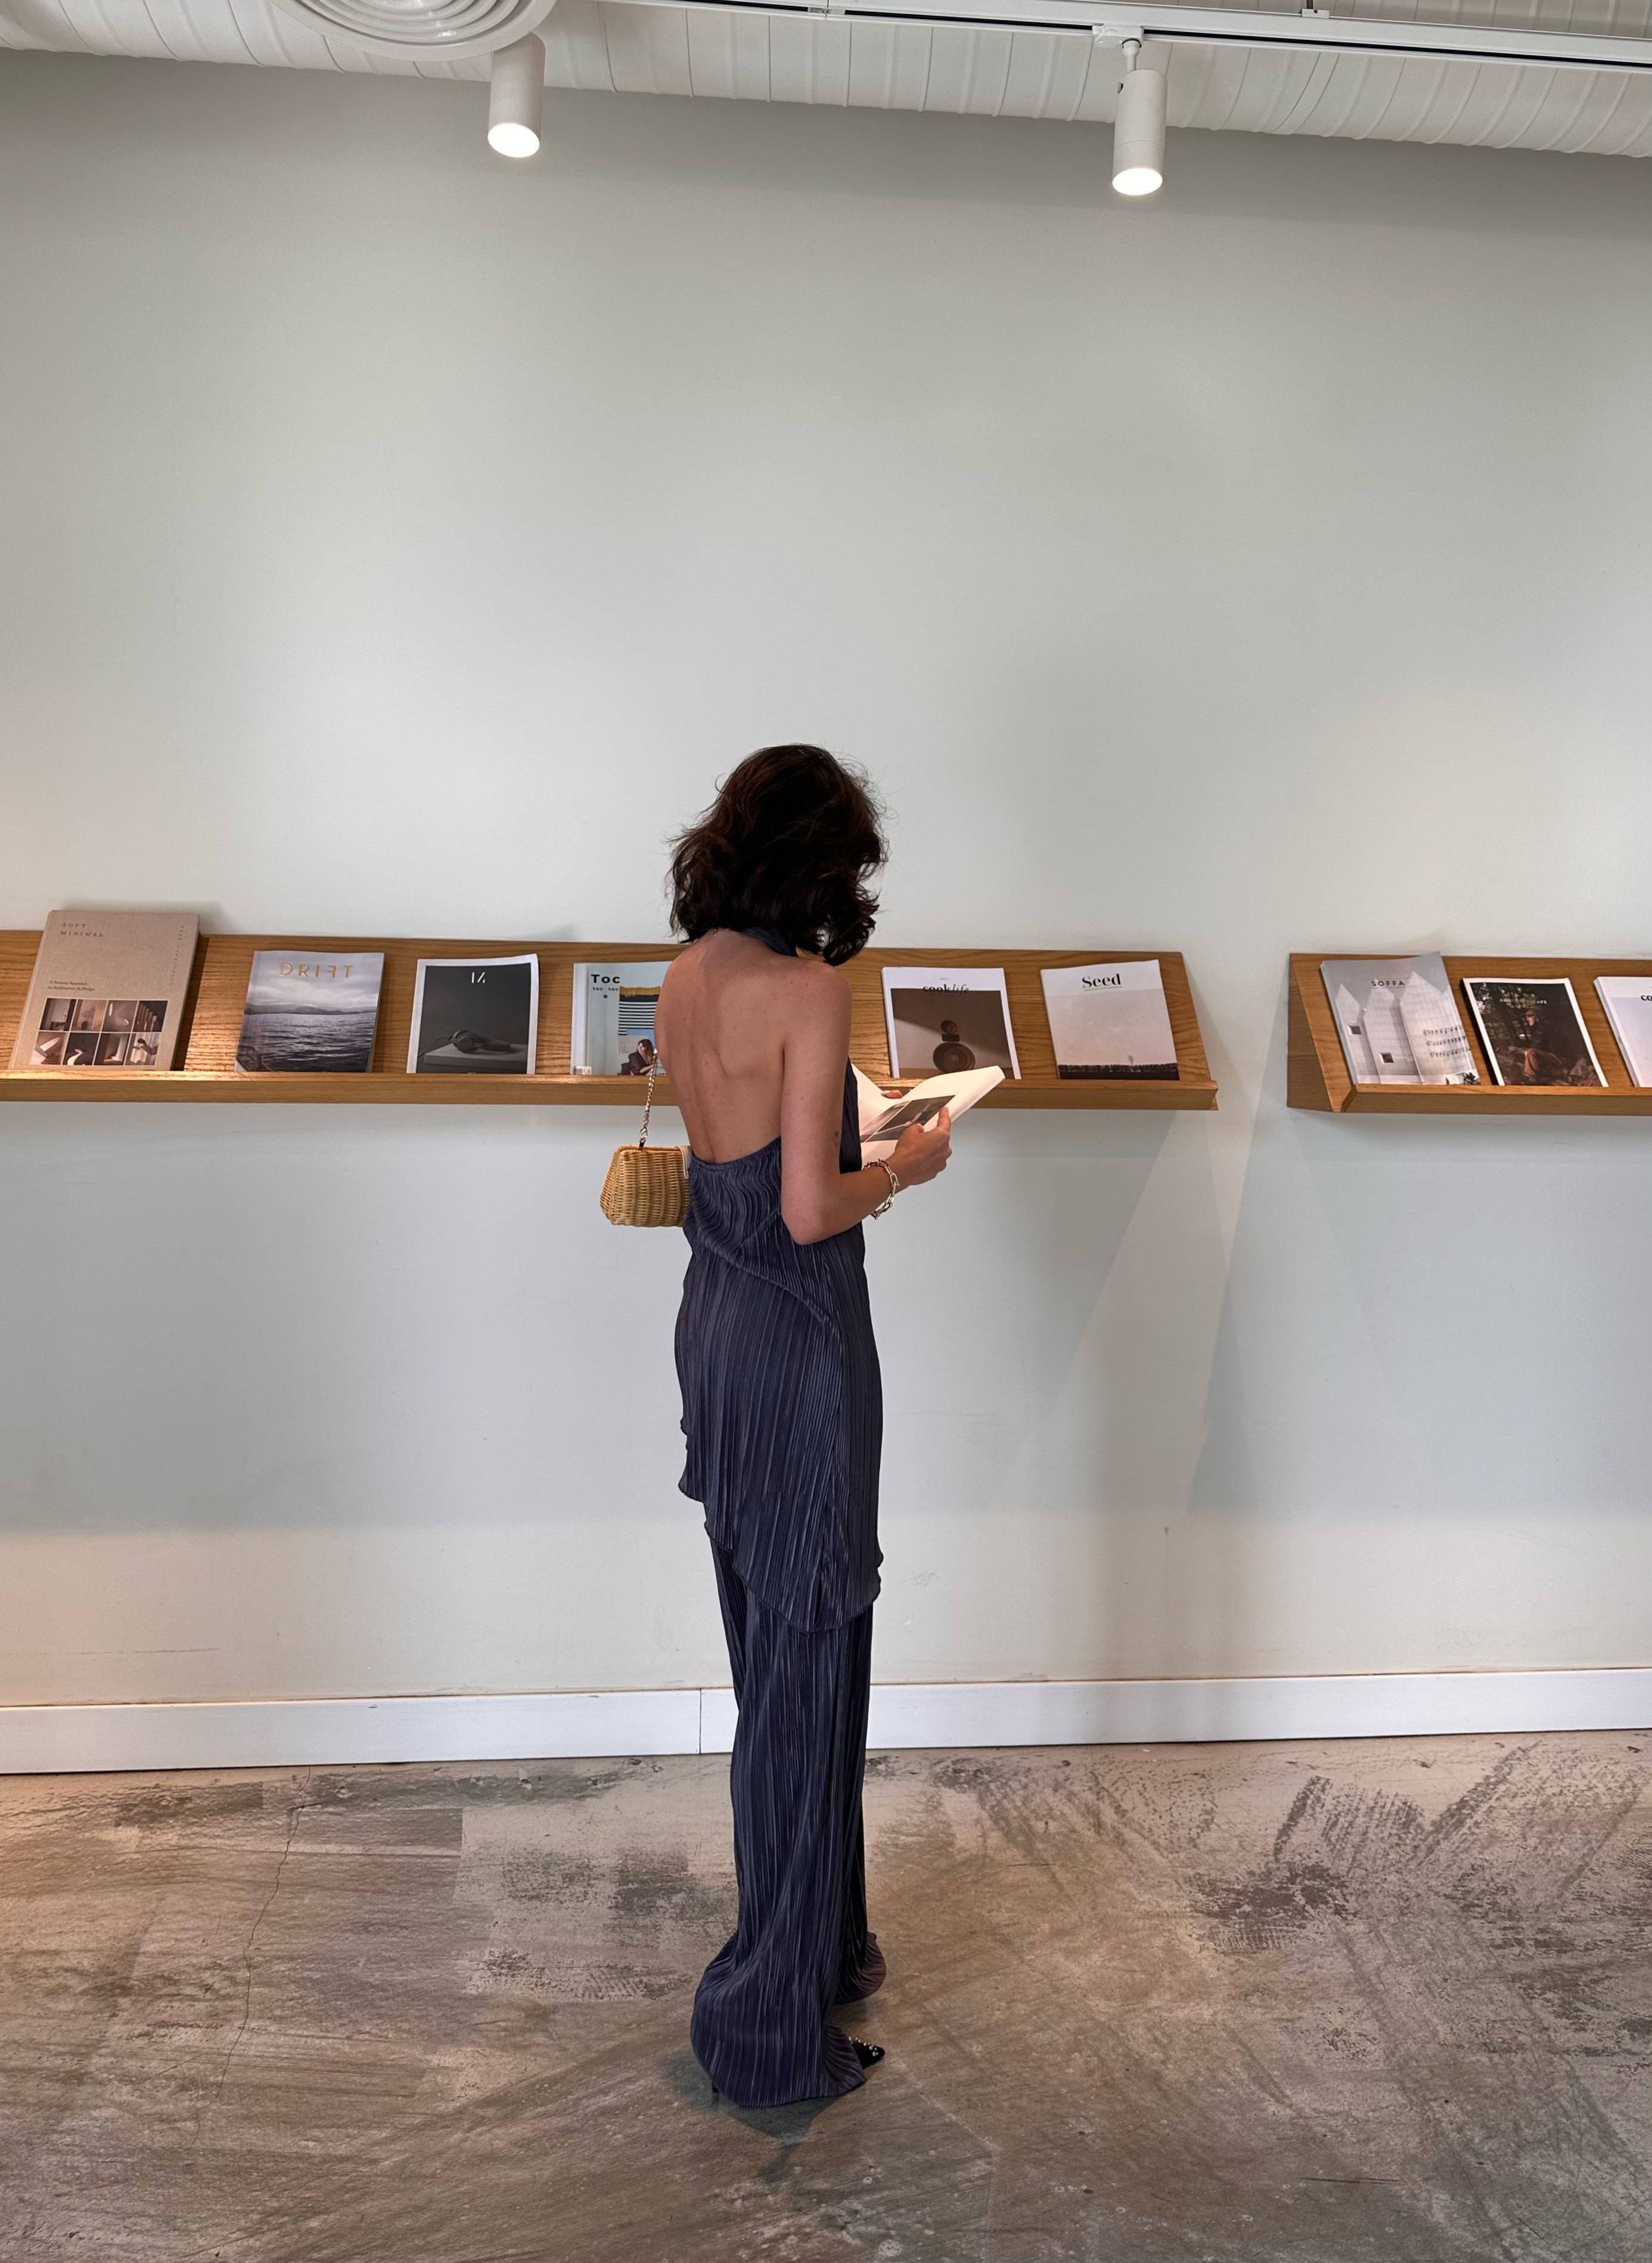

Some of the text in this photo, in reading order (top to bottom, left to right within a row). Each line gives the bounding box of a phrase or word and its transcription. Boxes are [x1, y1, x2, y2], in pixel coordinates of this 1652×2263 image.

[280, 963, 353, 978] DRIFT
[591, 974, 620, 983] Toc
[1082, 973, 1121, 988] Seed
